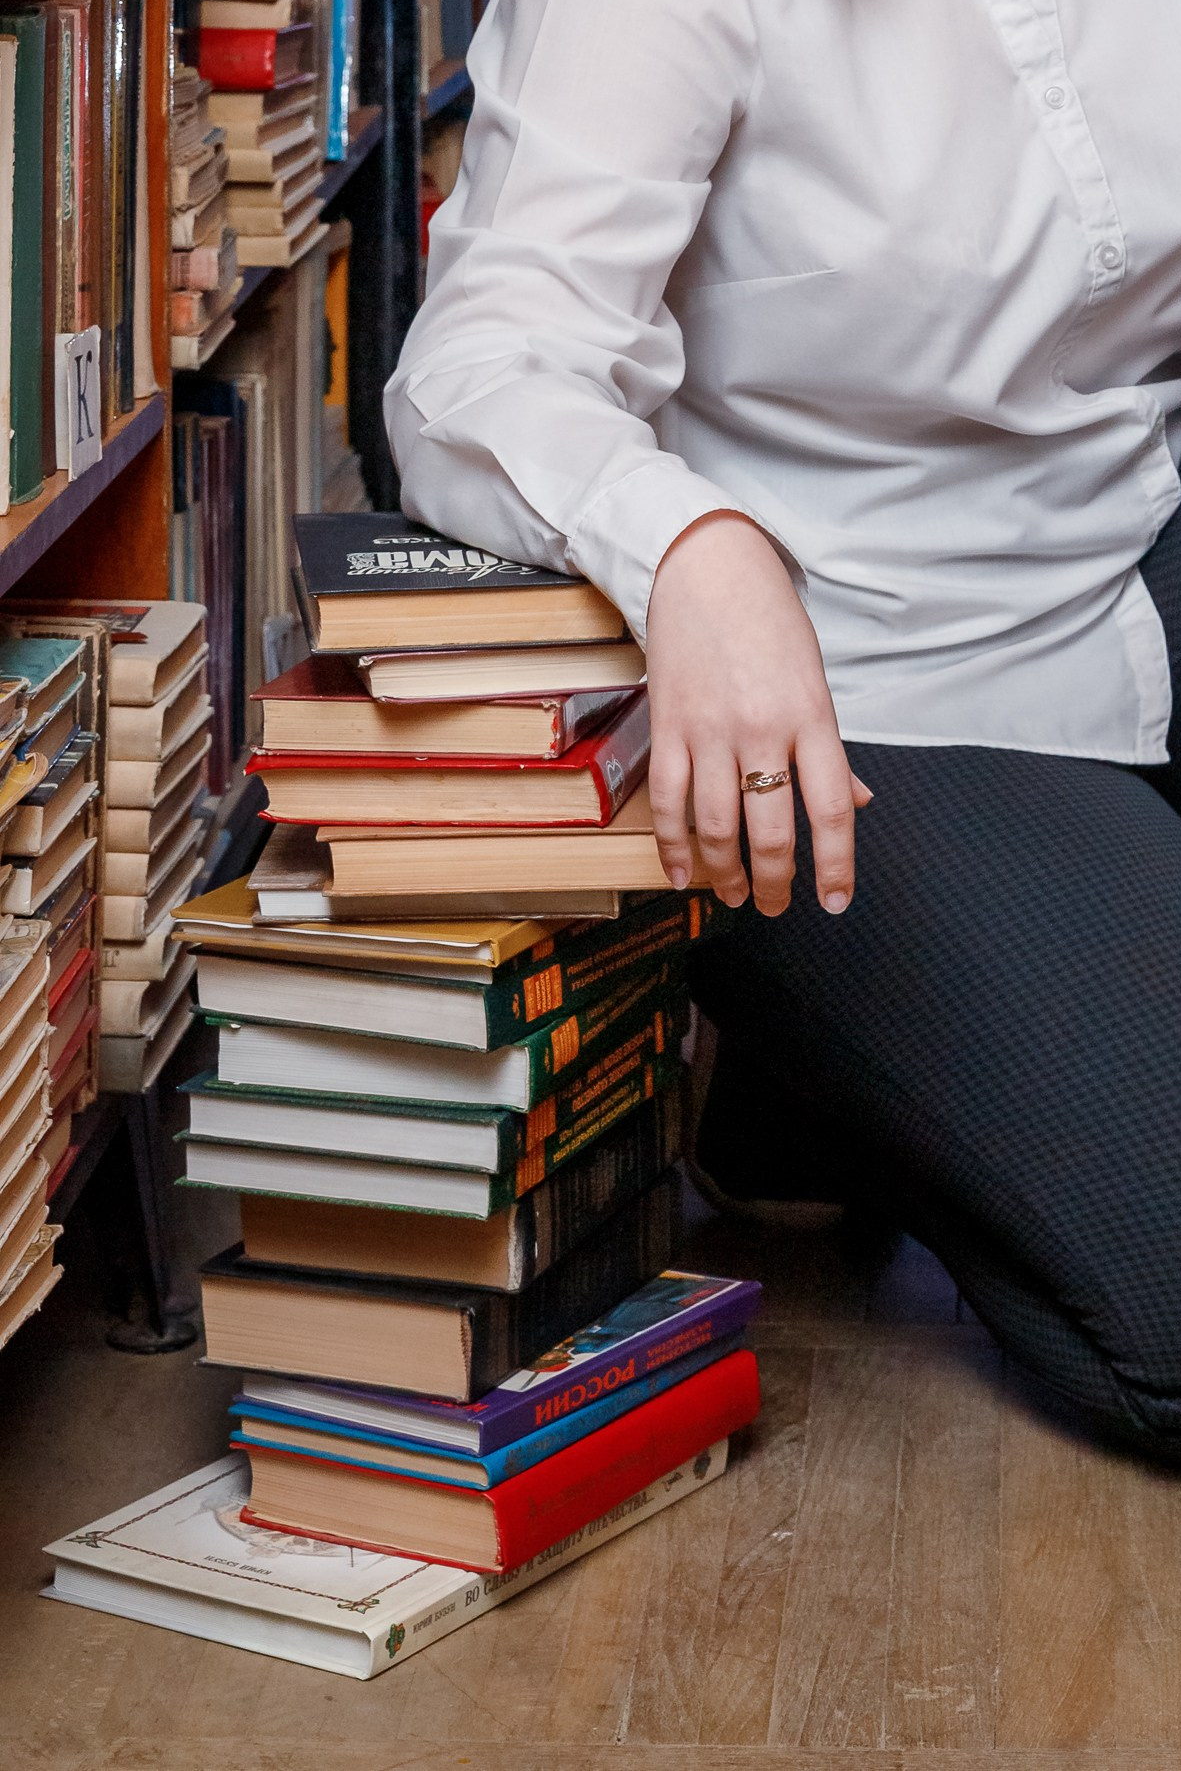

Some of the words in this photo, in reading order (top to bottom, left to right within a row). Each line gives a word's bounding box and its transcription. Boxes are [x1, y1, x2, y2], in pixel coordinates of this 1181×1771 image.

[75, 349, 96, 445] К
[347, 564, 541, 582] Александр
[534, 1358, 637, 1426] РОССИИ
[465, 1585, 480, 1608] ВО
